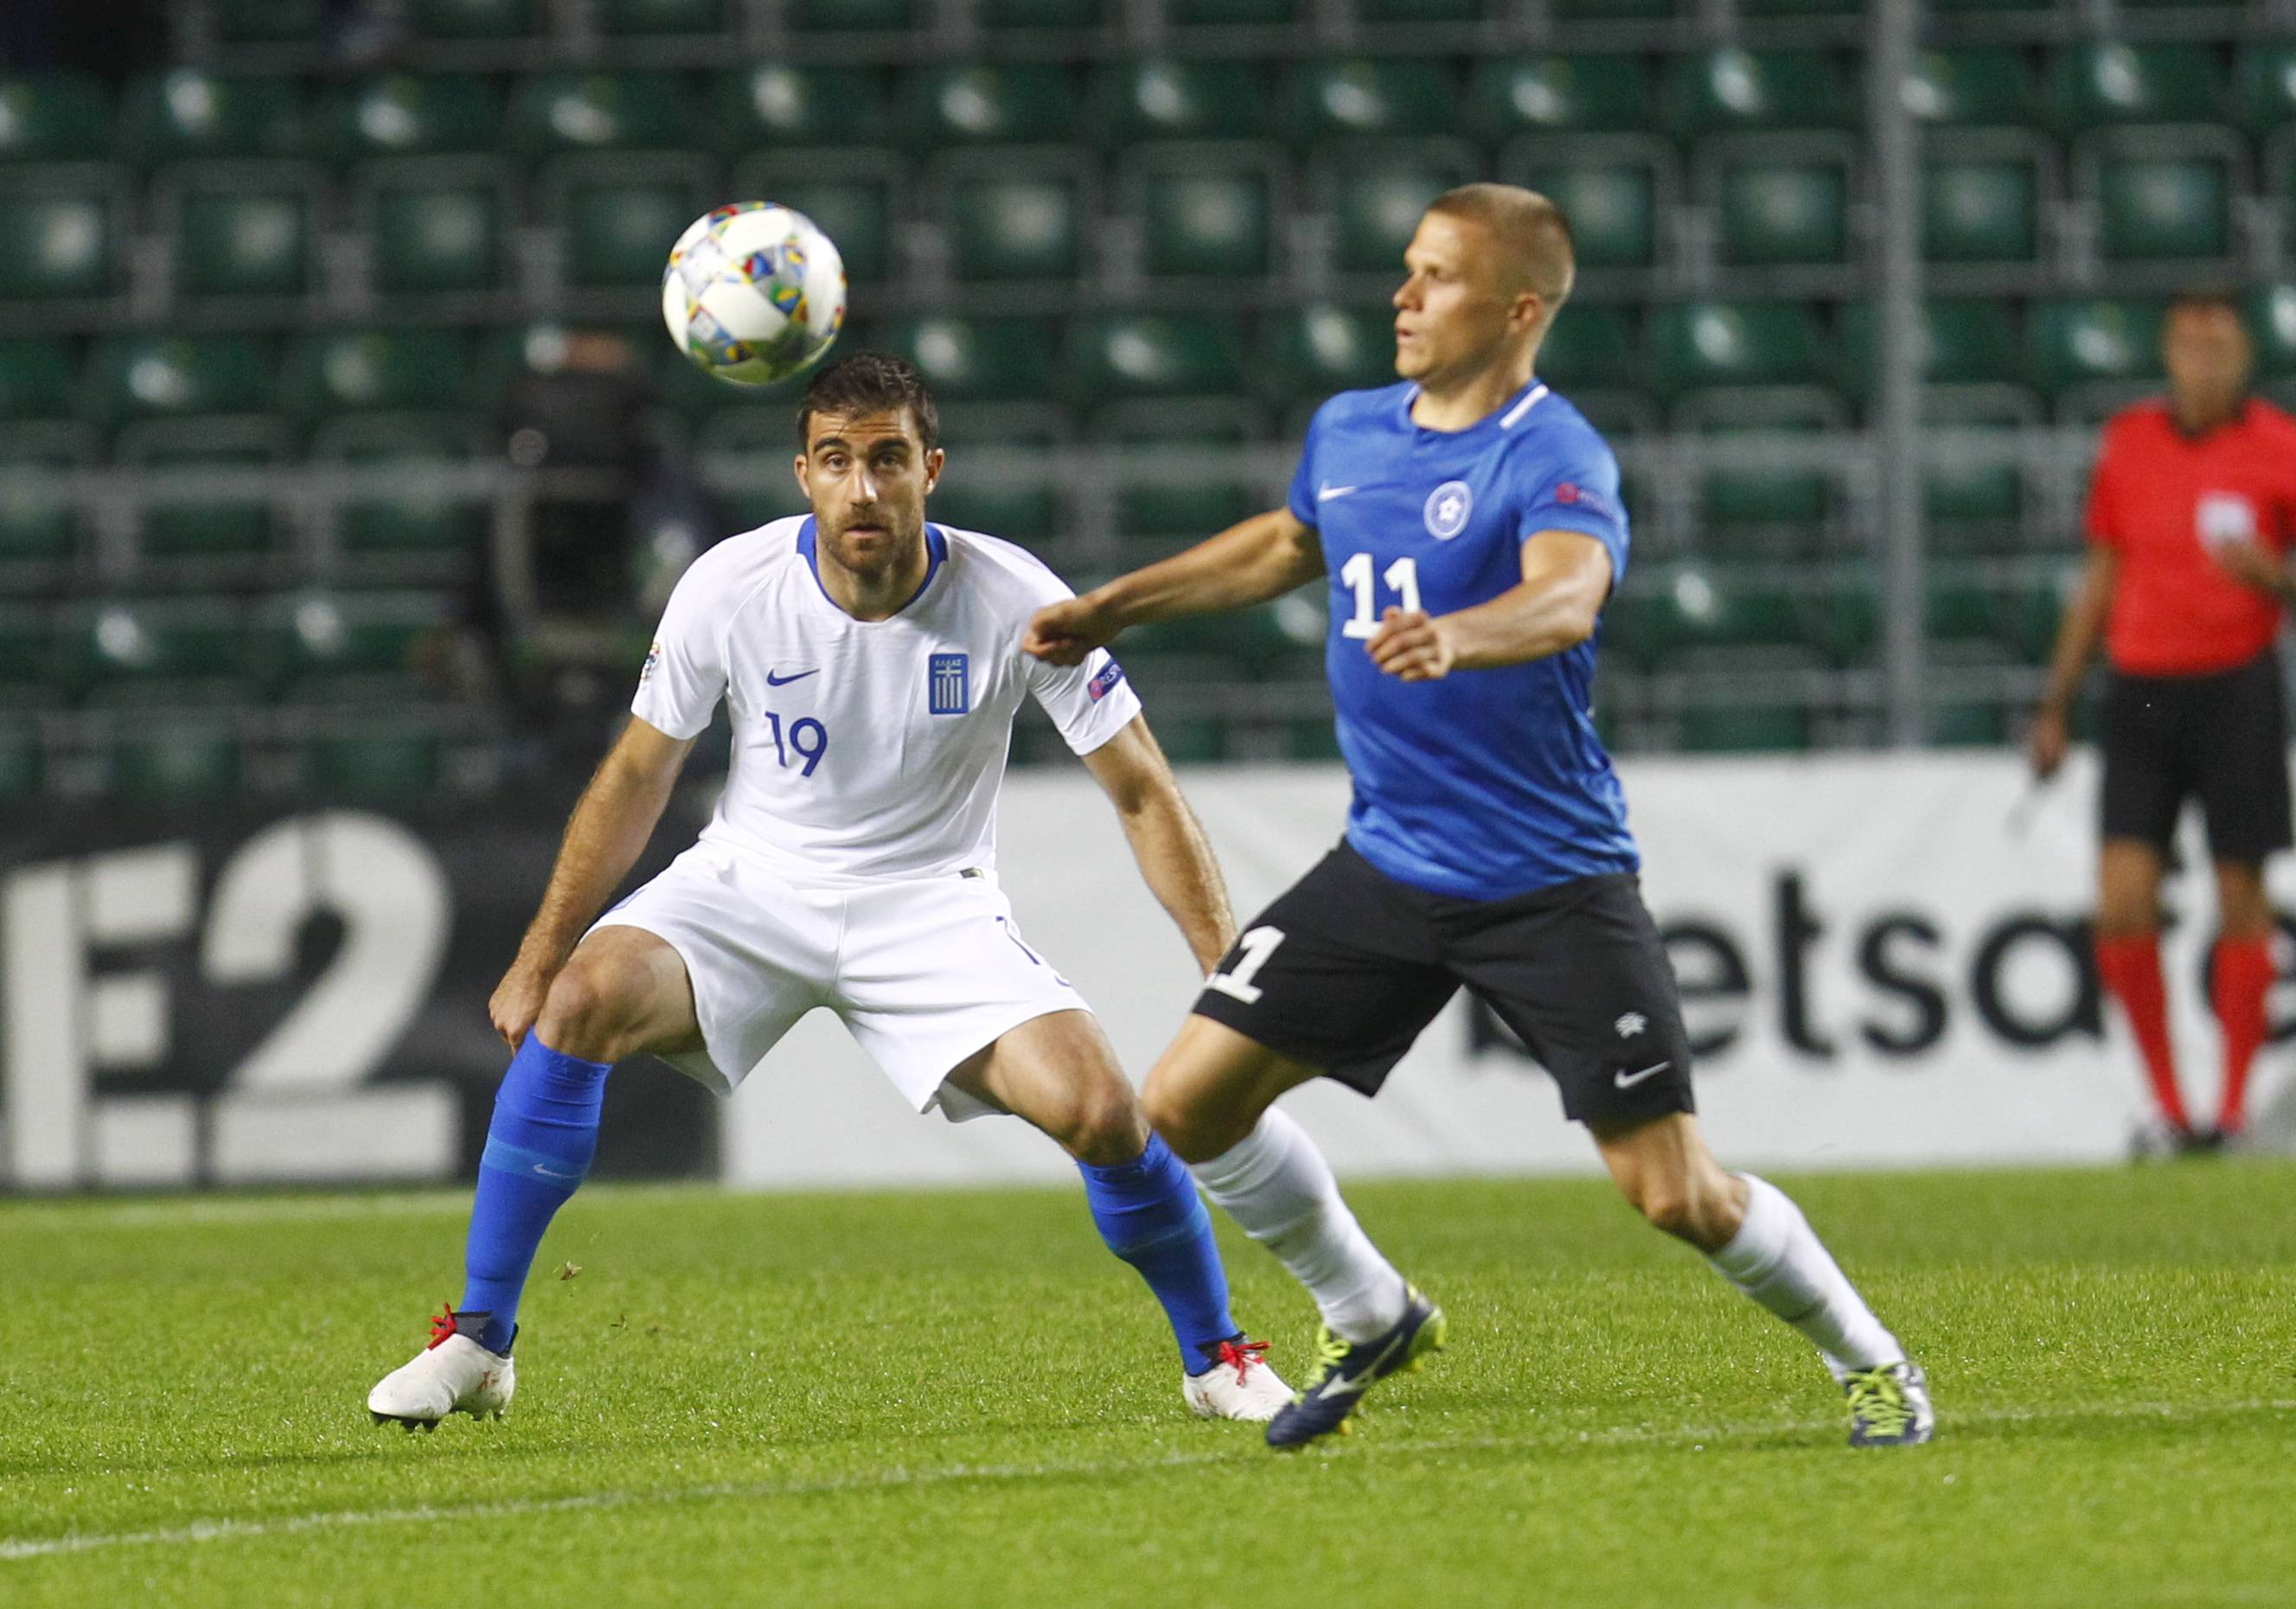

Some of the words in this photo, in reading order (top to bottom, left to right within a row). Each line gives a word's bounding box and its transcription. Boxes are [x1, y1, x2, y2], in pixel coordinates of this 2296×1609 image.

[1340, 552, 1421, 638] 11
[764, 711, 828, 777] 19
[7, 811, 460, 1186] E2
[1205, 925, 1285, 1004] 1
[1463, 869, 2296, 1062] etsa
